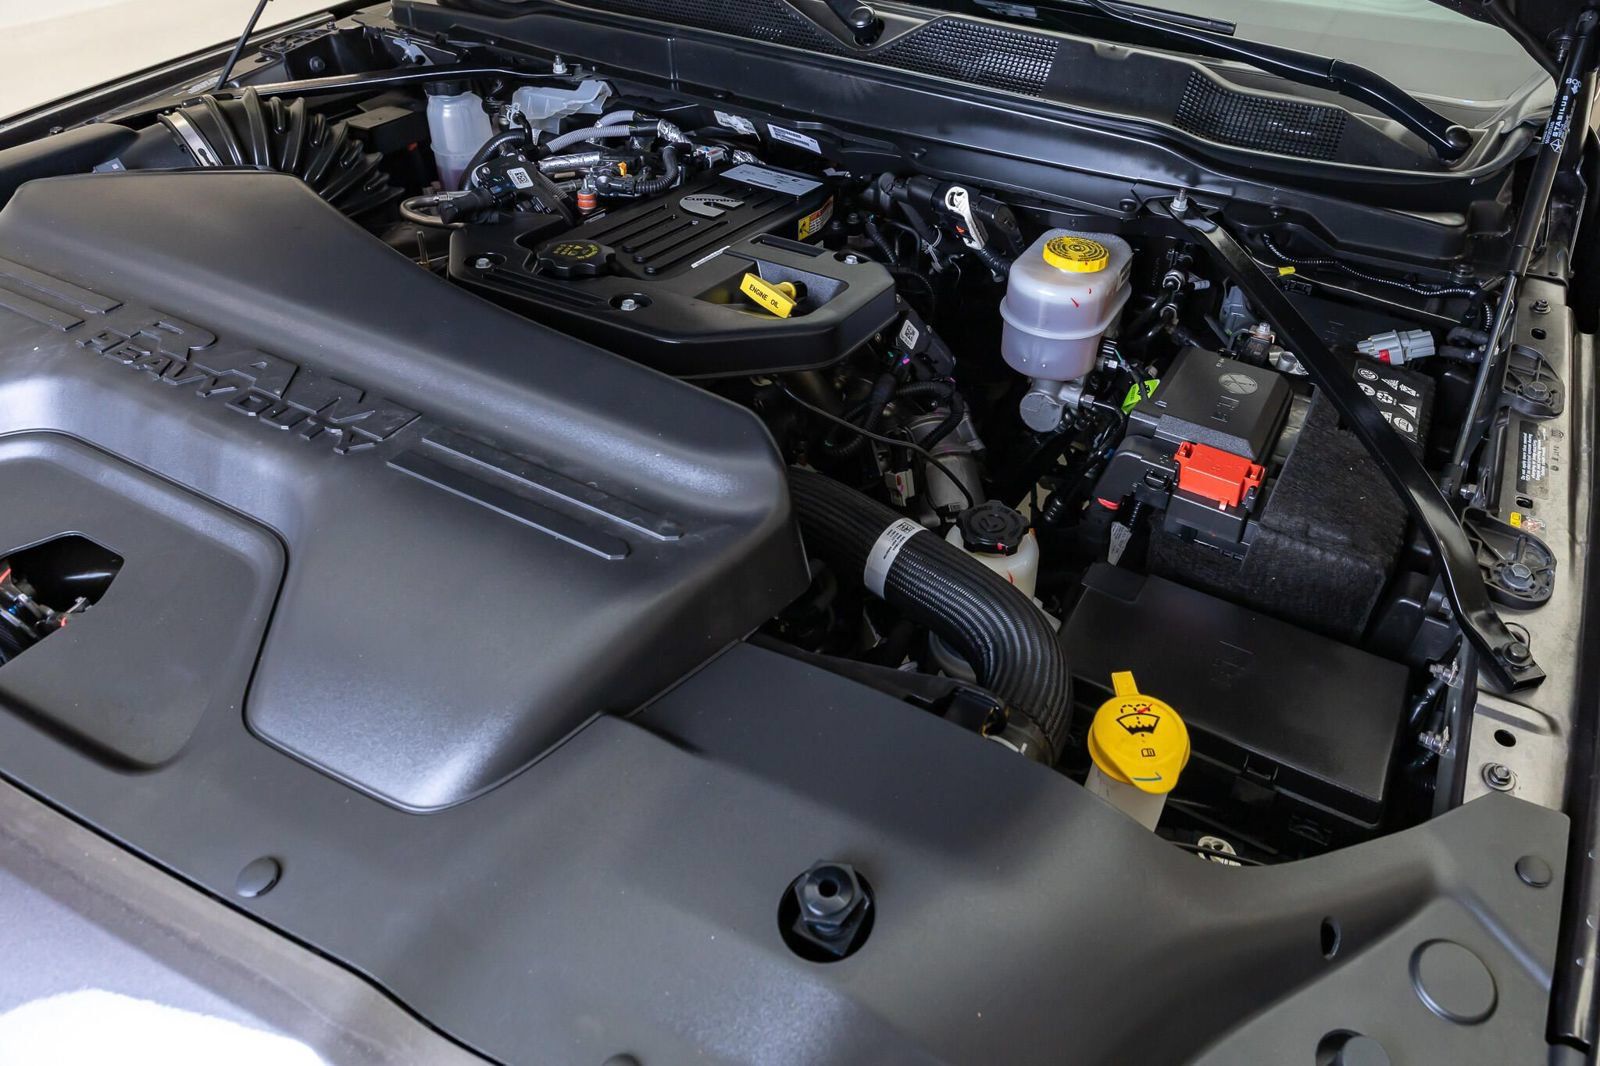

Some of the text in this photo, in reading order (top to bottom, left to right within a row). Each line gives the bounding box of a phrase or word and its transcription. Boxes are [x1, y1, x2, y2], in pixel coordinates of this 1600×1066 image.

[1552, 95, 1569, 137] STABILUS
[749, 283, 780, 309] ENGINE OIL
[75, 326, 377, 454] HEAVY DUTY
[128, 307, 423, 441] RAM
